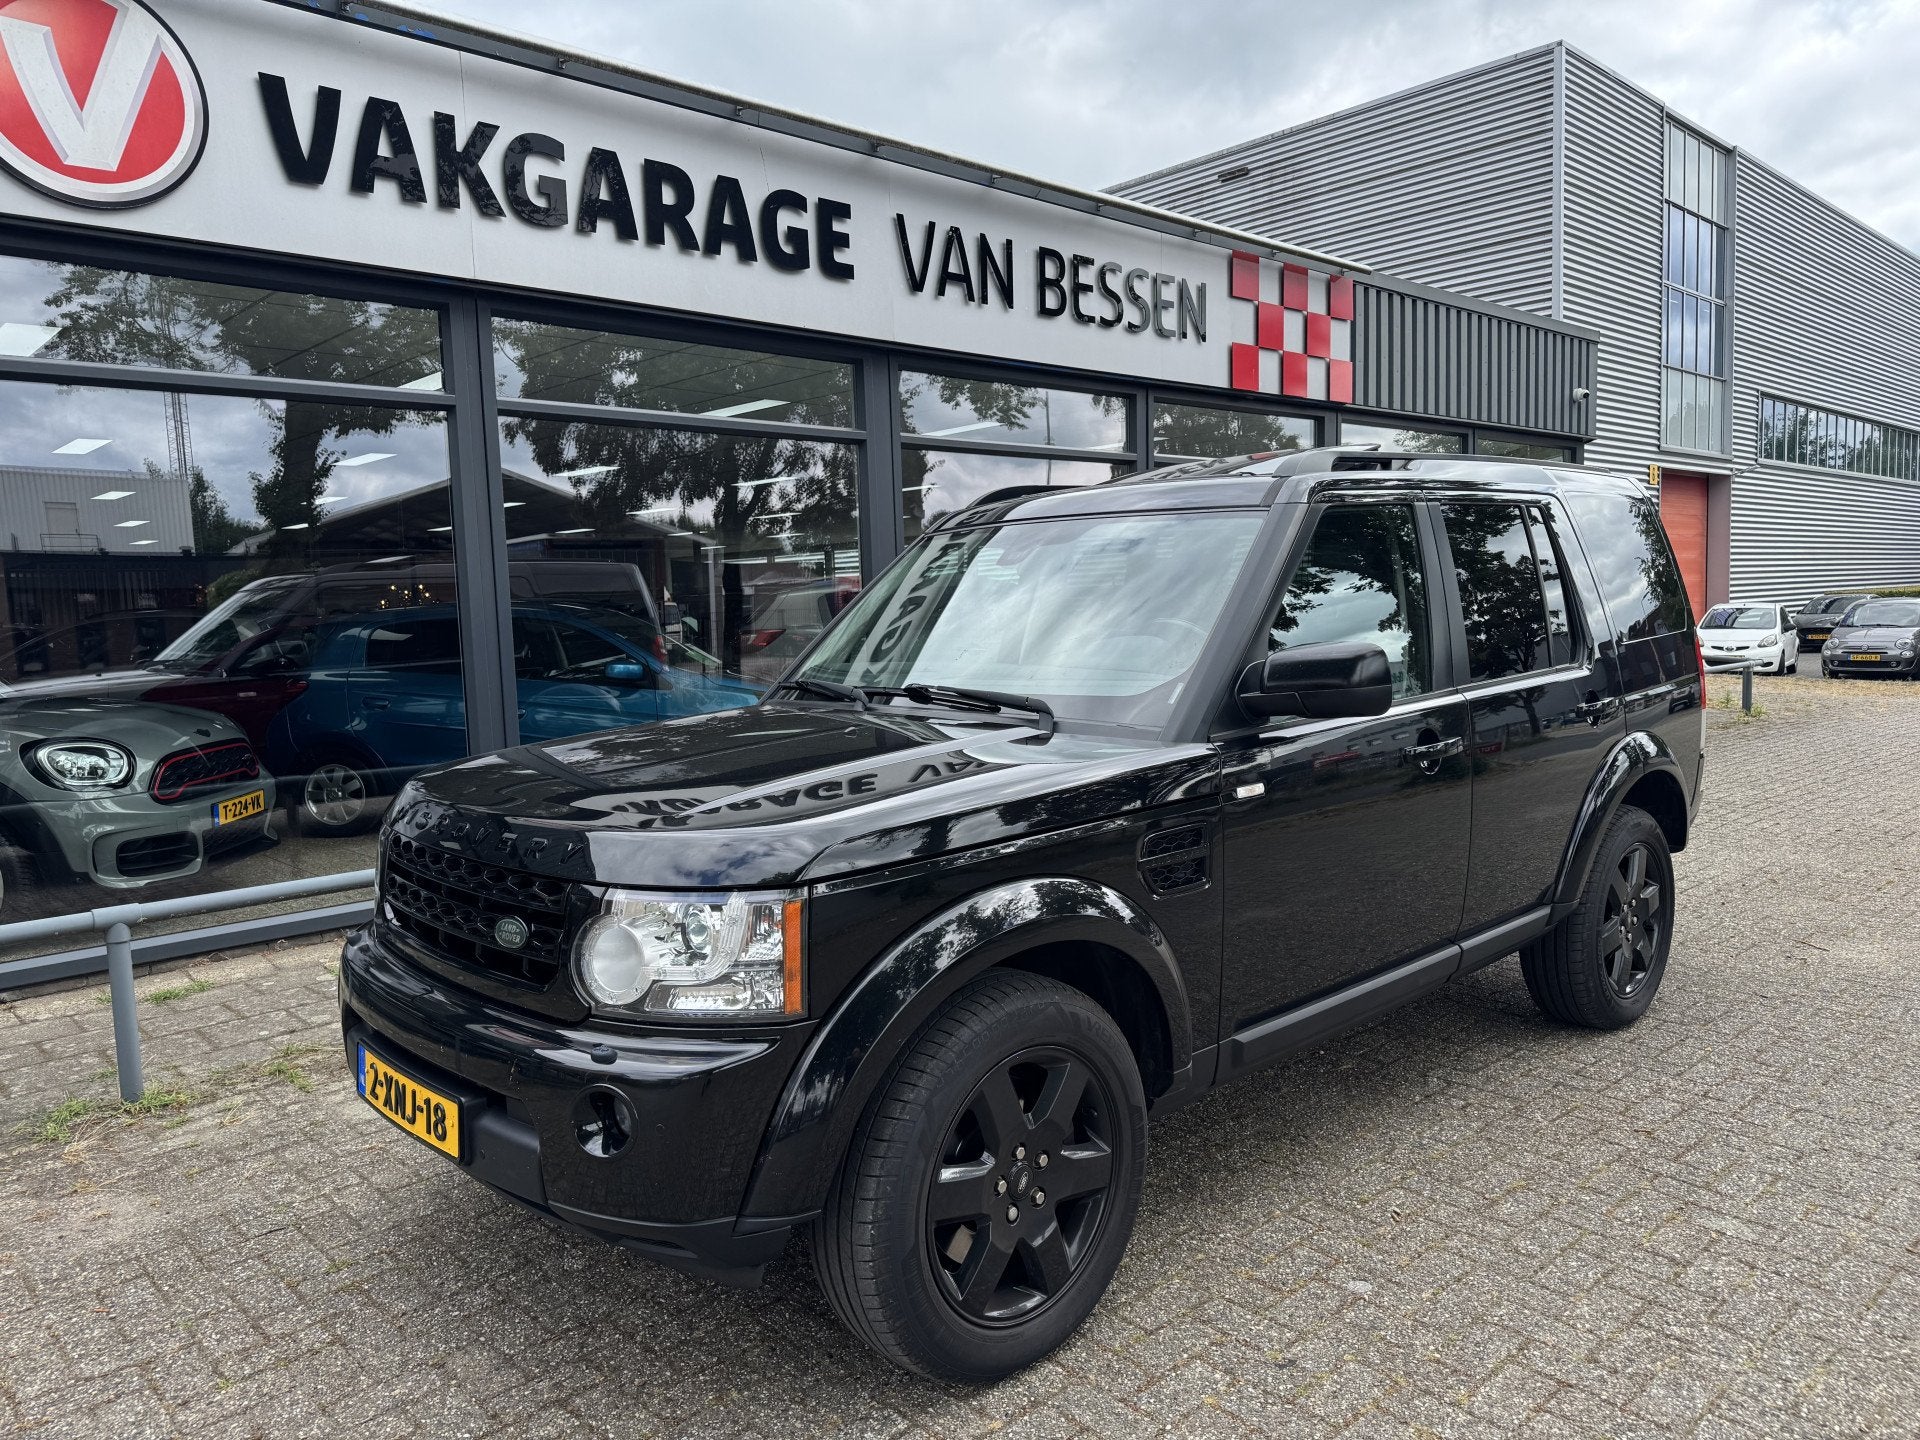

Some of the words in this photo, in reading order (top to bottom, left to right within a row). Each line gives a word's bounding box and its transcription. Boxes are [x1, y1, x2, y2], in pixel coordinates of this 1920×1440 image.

[258, 71, 855, 281] VAKGARAGE
[896, 213, 1014, 309] VAN
[1037, 246, 1207, 343] BESSEN
[222, 794, 262, 820] T-224-VK
[501, 922, 517, 933] LAND
[502, 931, 520, 944] ROVER
[369, 1062, 448, 1142] 2-XNJ-18
